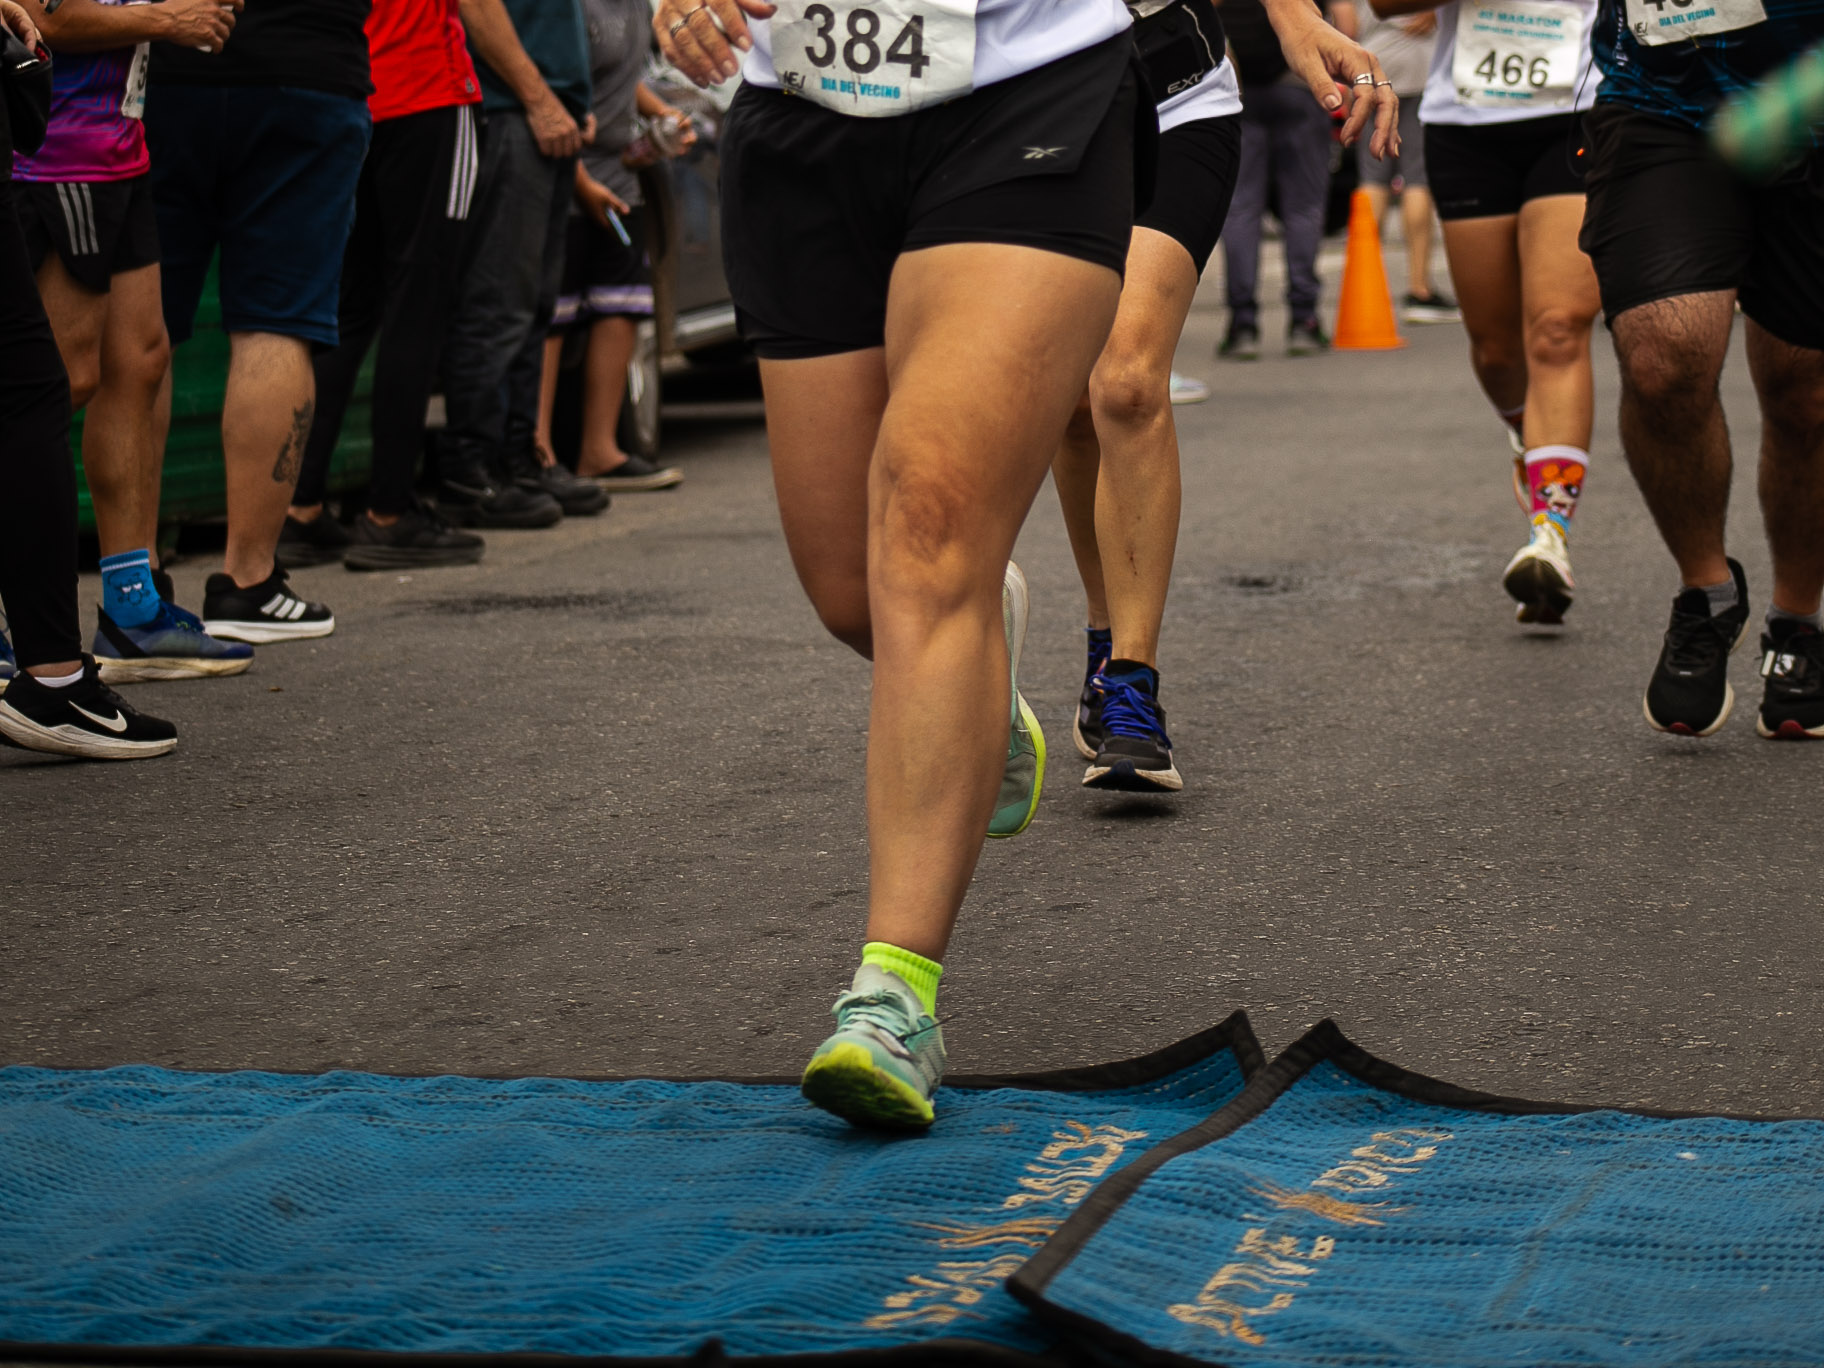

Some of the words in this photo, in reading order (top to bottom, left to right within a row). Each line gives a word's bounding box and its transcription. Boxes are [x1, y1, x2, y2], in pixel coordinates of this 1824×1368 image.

[802, 3, 931, 79] 384
[1475, 48, 1550, 89] 466
[858, 82, 902, 100] VECINO
